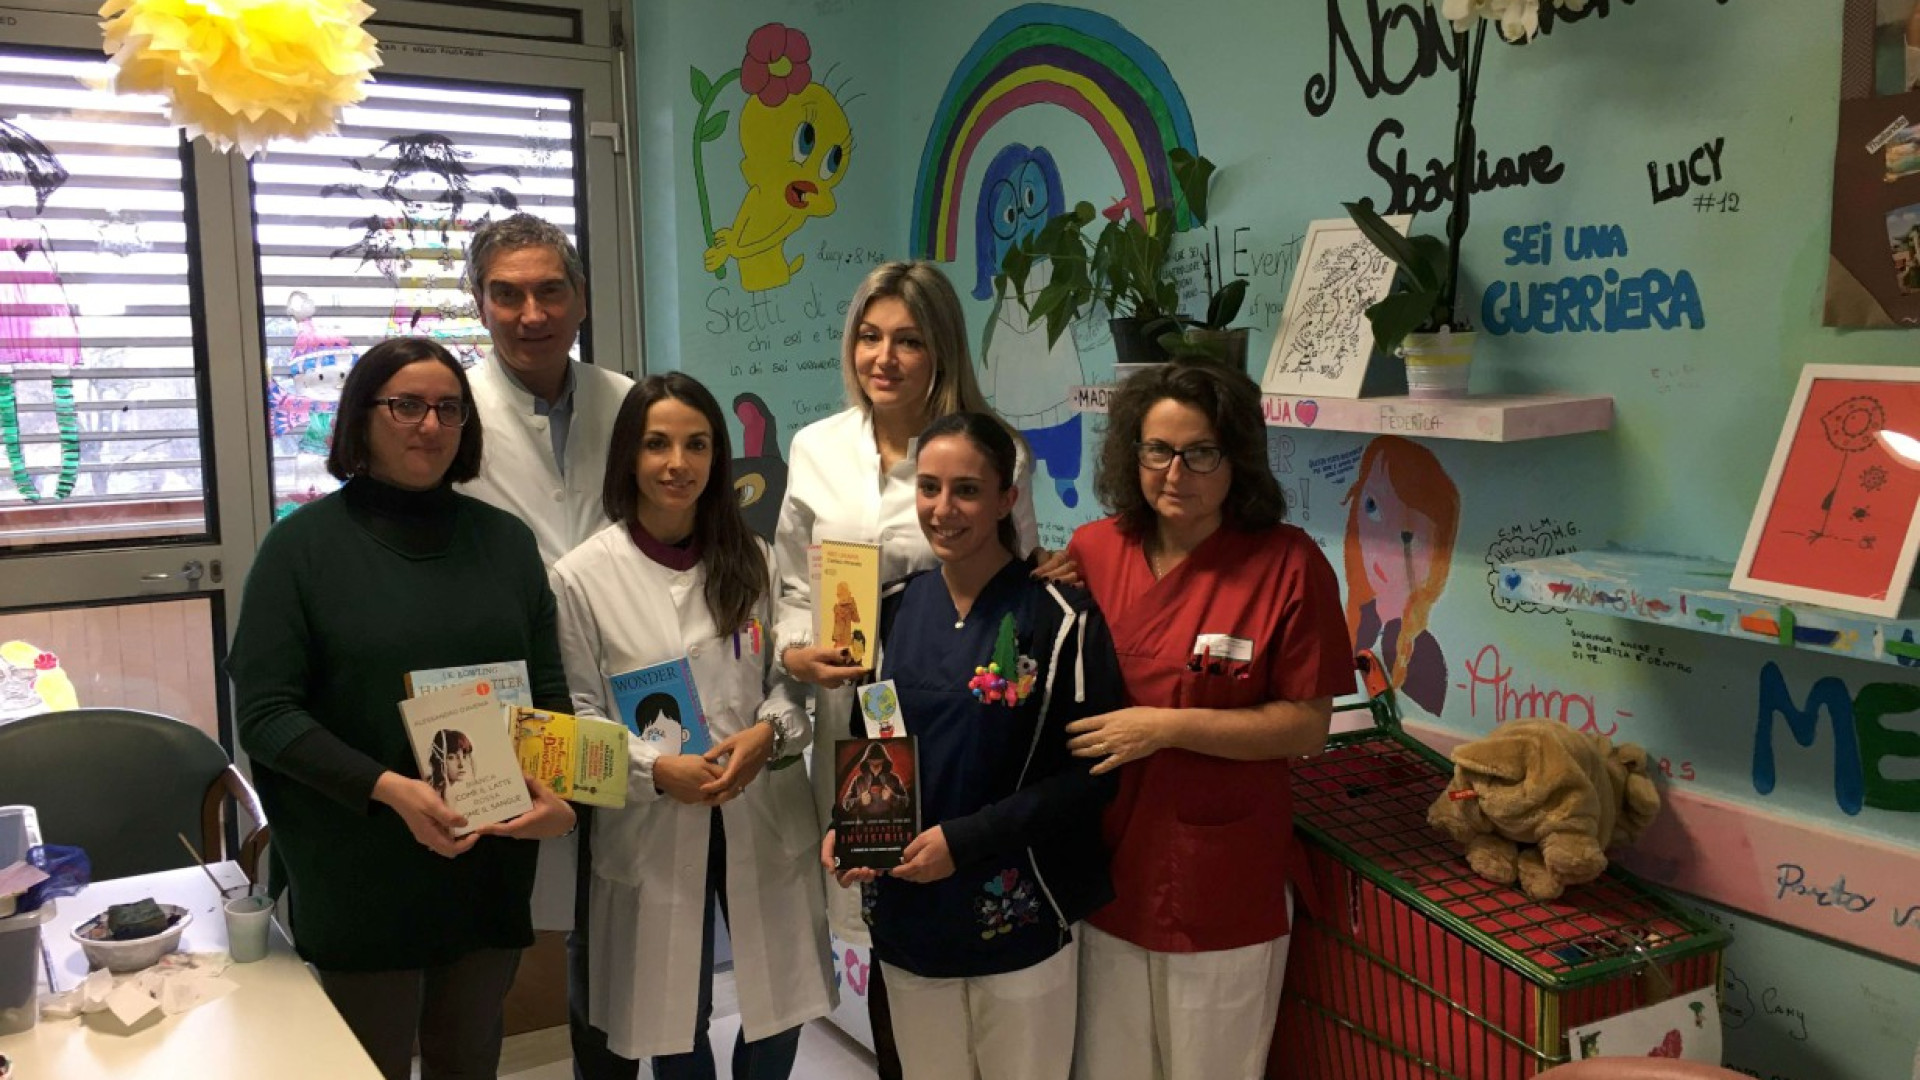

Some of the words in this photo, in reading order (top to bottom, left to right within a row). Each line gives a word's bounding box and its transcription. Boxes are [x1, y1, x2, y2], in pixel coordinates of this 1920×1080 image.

[1647, 137, 1725, 204] LUCY
[1693, 192, 1740, 212] #12
[1564, 224, 1628, 260] UNA
[615, 666, 680, 692] WONDER
